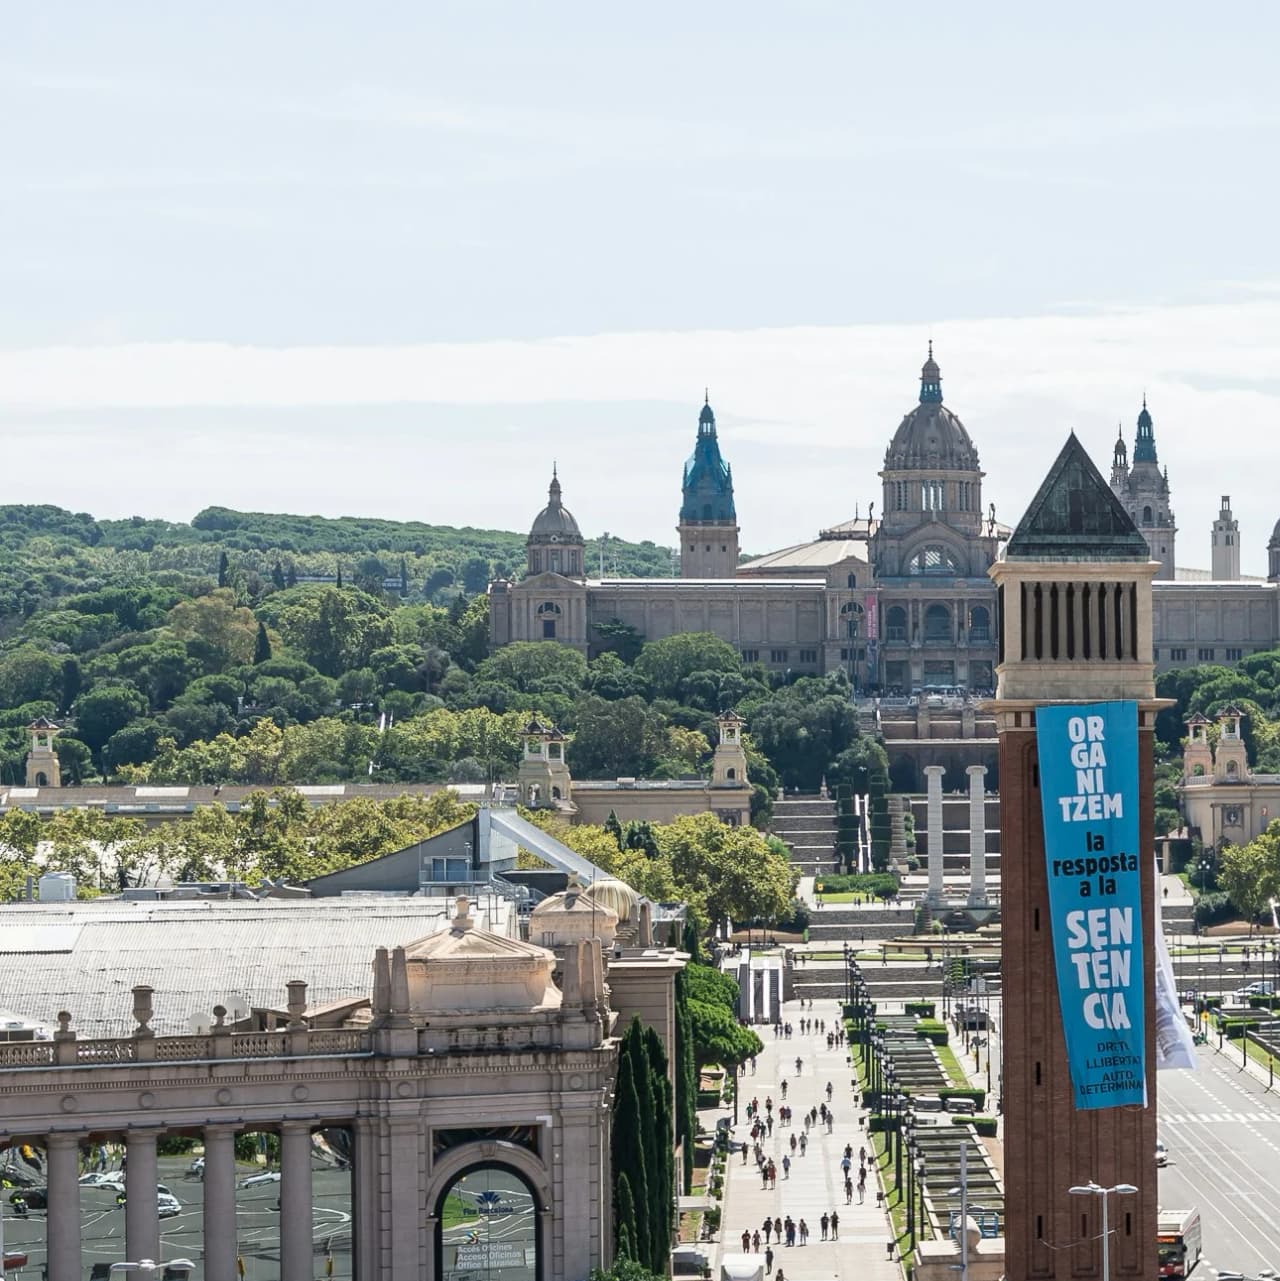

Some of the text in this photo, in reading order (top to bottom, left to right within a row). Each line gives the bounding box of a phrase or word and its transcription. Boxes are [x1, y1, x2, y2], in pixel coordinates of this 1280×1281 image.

[1068, 715, 1105, 743] OR
[1070, 742, 1107, 769] GA
[1076, 768, 1105, 795] NI
[1058, 793, 1123, 822] TZEM
[1086, 832, 1105, 852] la
[1053, 852, 1138, 877] resposta
[1079, 875, 1116, 897] a la
[1066, 907, 1133, 949] SEN
[1071, 945, 1131, 989] TÈN
[1083, 992, 1131, 1030] CIA
